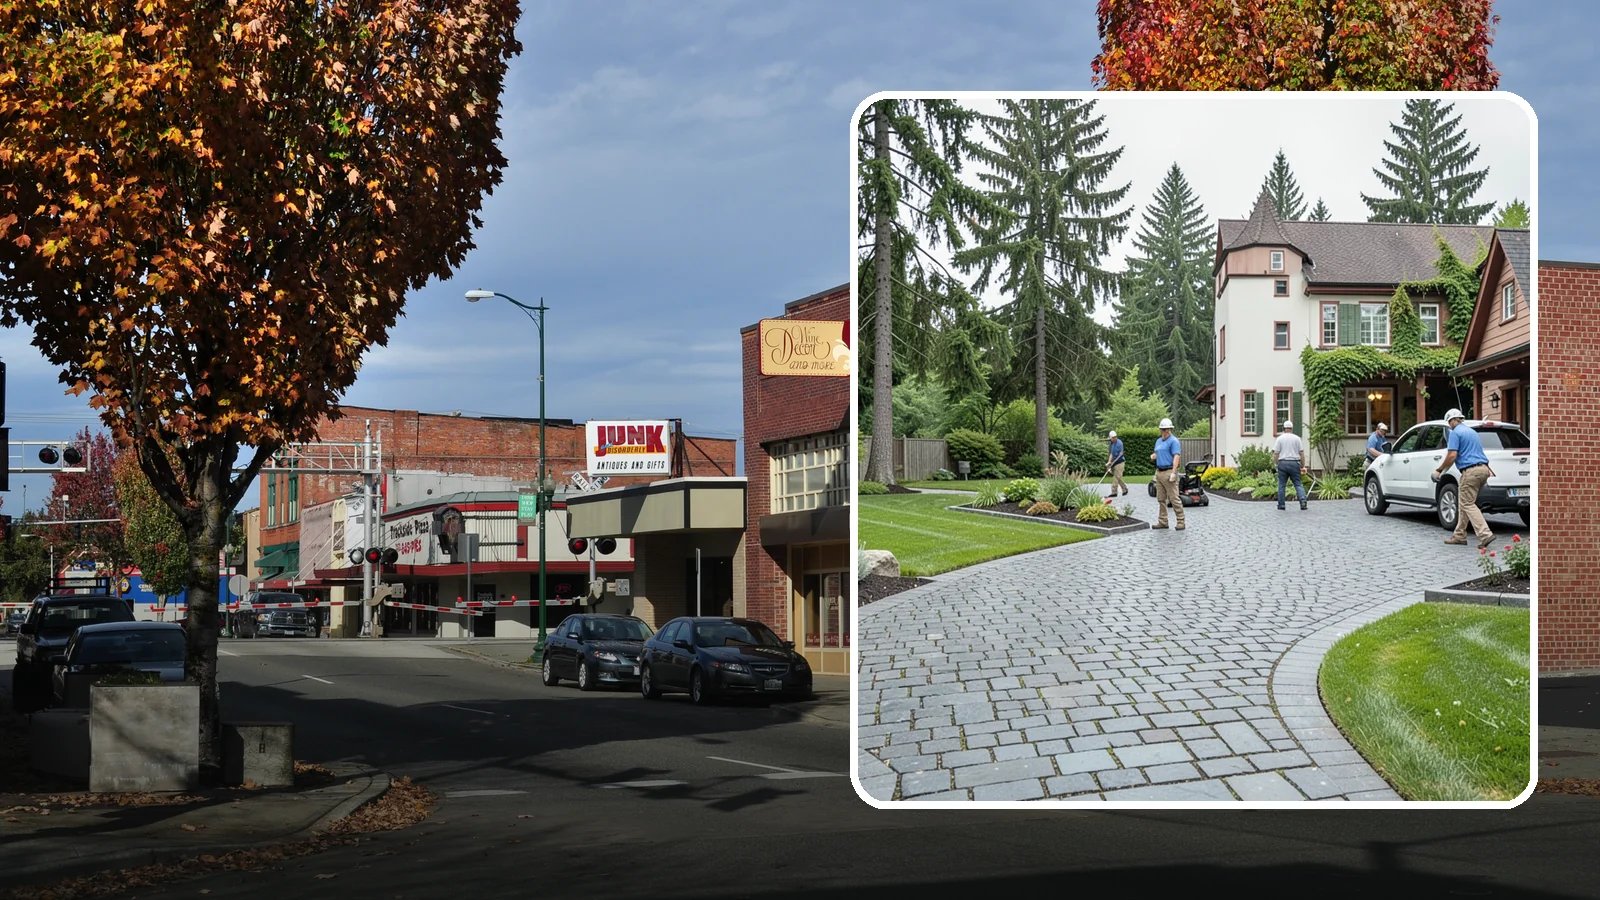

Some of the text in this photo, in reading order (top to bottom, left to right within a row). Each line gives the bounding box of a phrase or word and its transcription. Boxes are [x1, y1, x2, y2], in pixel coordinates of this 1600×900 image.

[595, 425, 665, 457] JUNK
[607, 446, 645, 454] DISORDERLY
[596, 460, 665, 470] ANTIQUES AND GIFTS
[390, 519, 429, 540] Trackside Pizza
